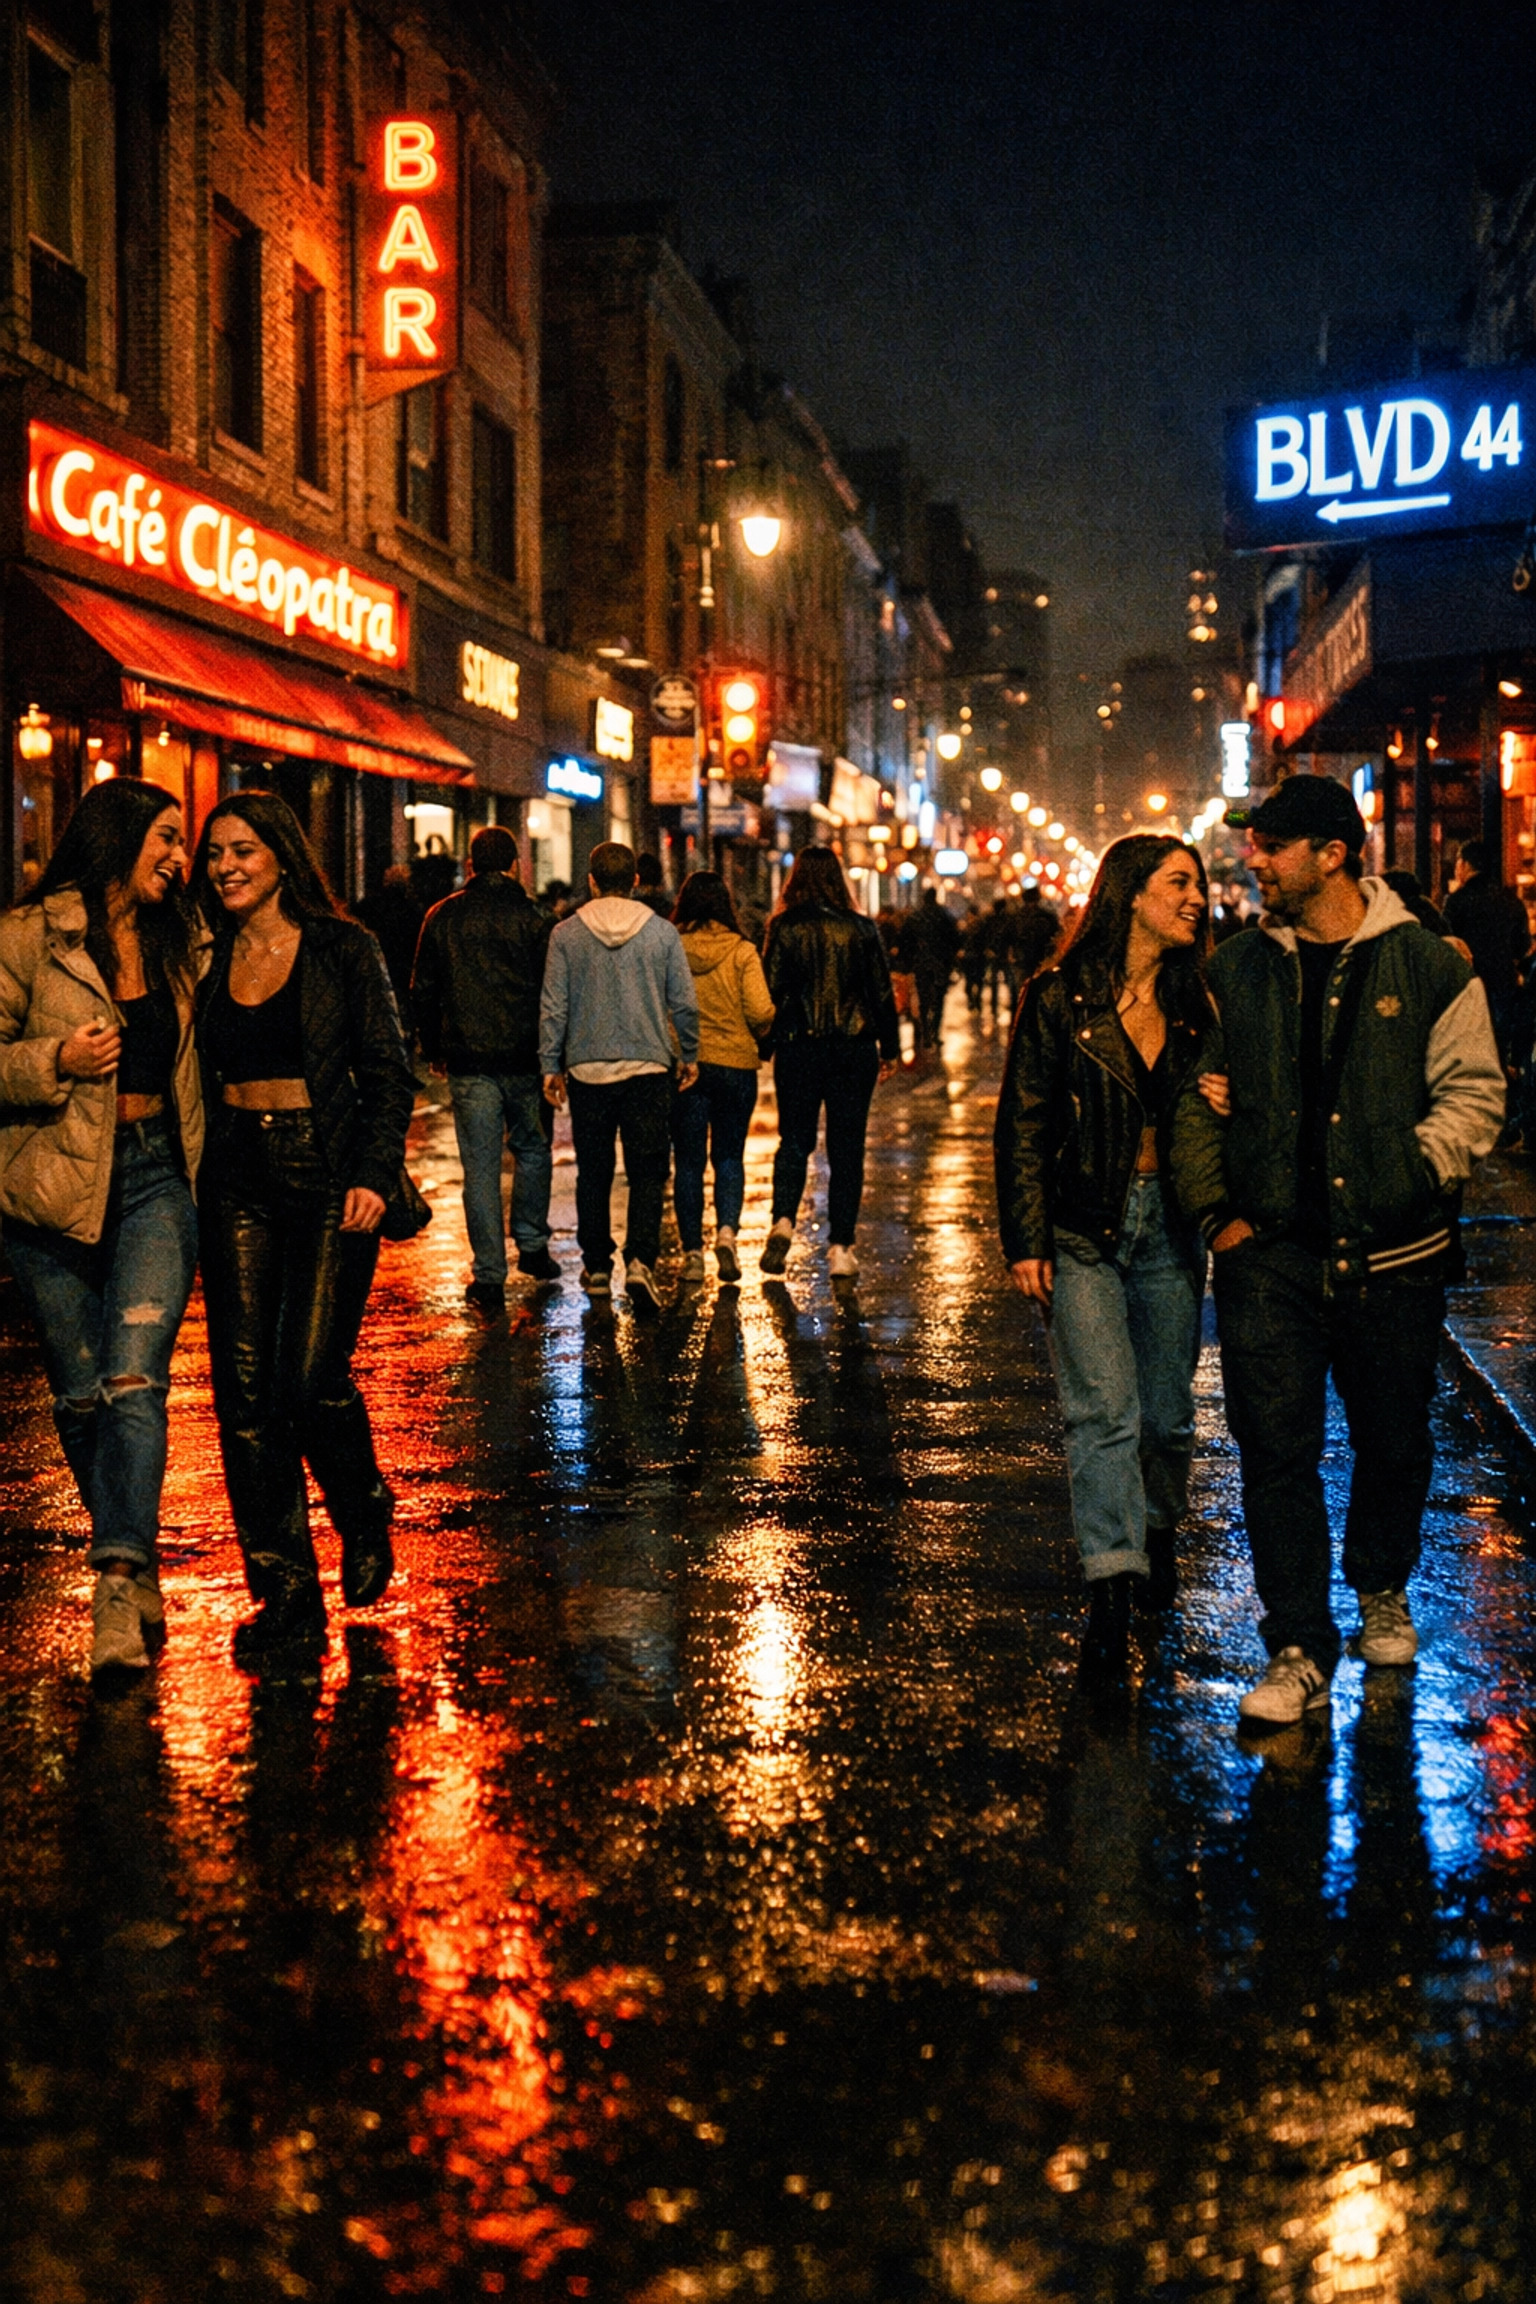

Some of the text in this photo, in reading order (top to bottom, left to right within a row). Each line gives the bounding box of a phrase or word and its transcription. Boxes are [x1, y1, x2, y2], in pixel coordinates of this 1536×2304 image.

[378, 121, 439, 358] BAR
[50, 449, 167, 567] Café
[1255, 398, 1522, 502] BLVD 44
